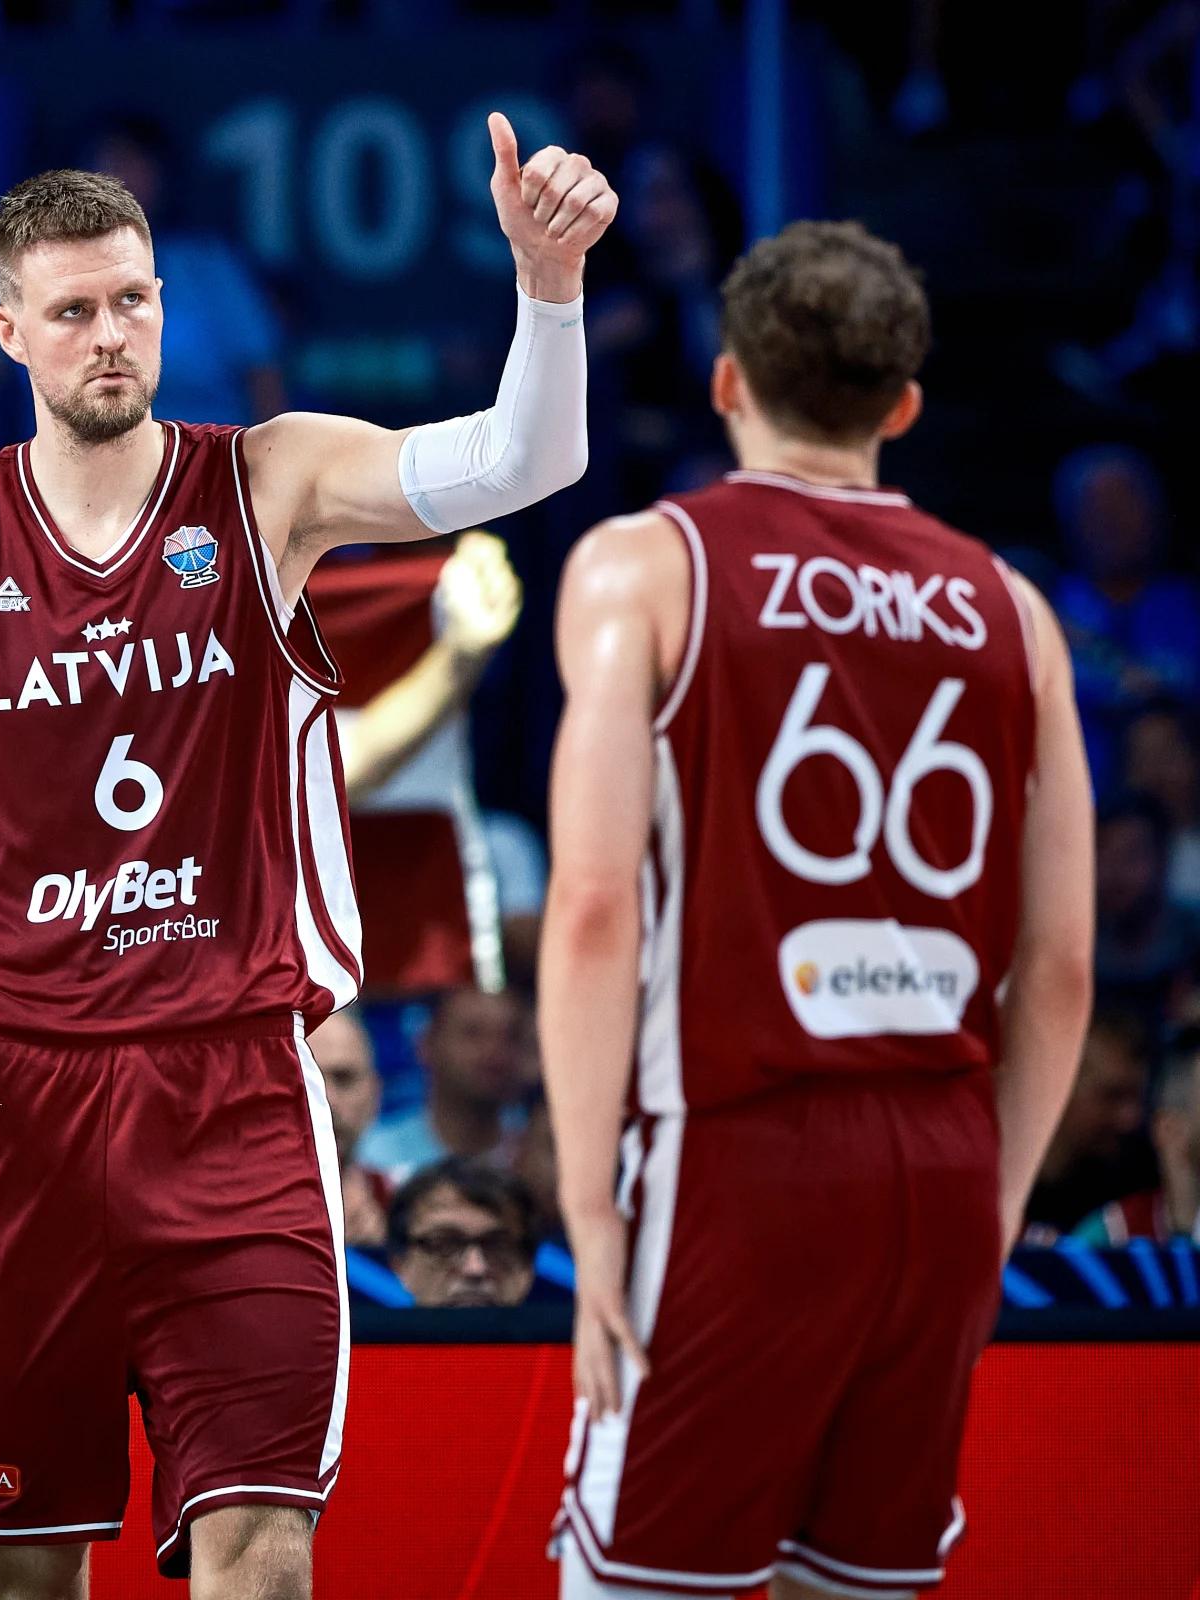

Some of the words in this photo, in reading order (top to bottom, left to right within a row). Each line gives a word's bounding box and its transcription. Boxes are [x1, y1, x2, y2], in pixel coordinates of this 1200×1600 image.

[752, 553, 987, 650] ZORIKS
[94, 733, 164, 831] 6
[755, 662, 994, 900] 66
[26, 856, 203, 932] OlyBet
